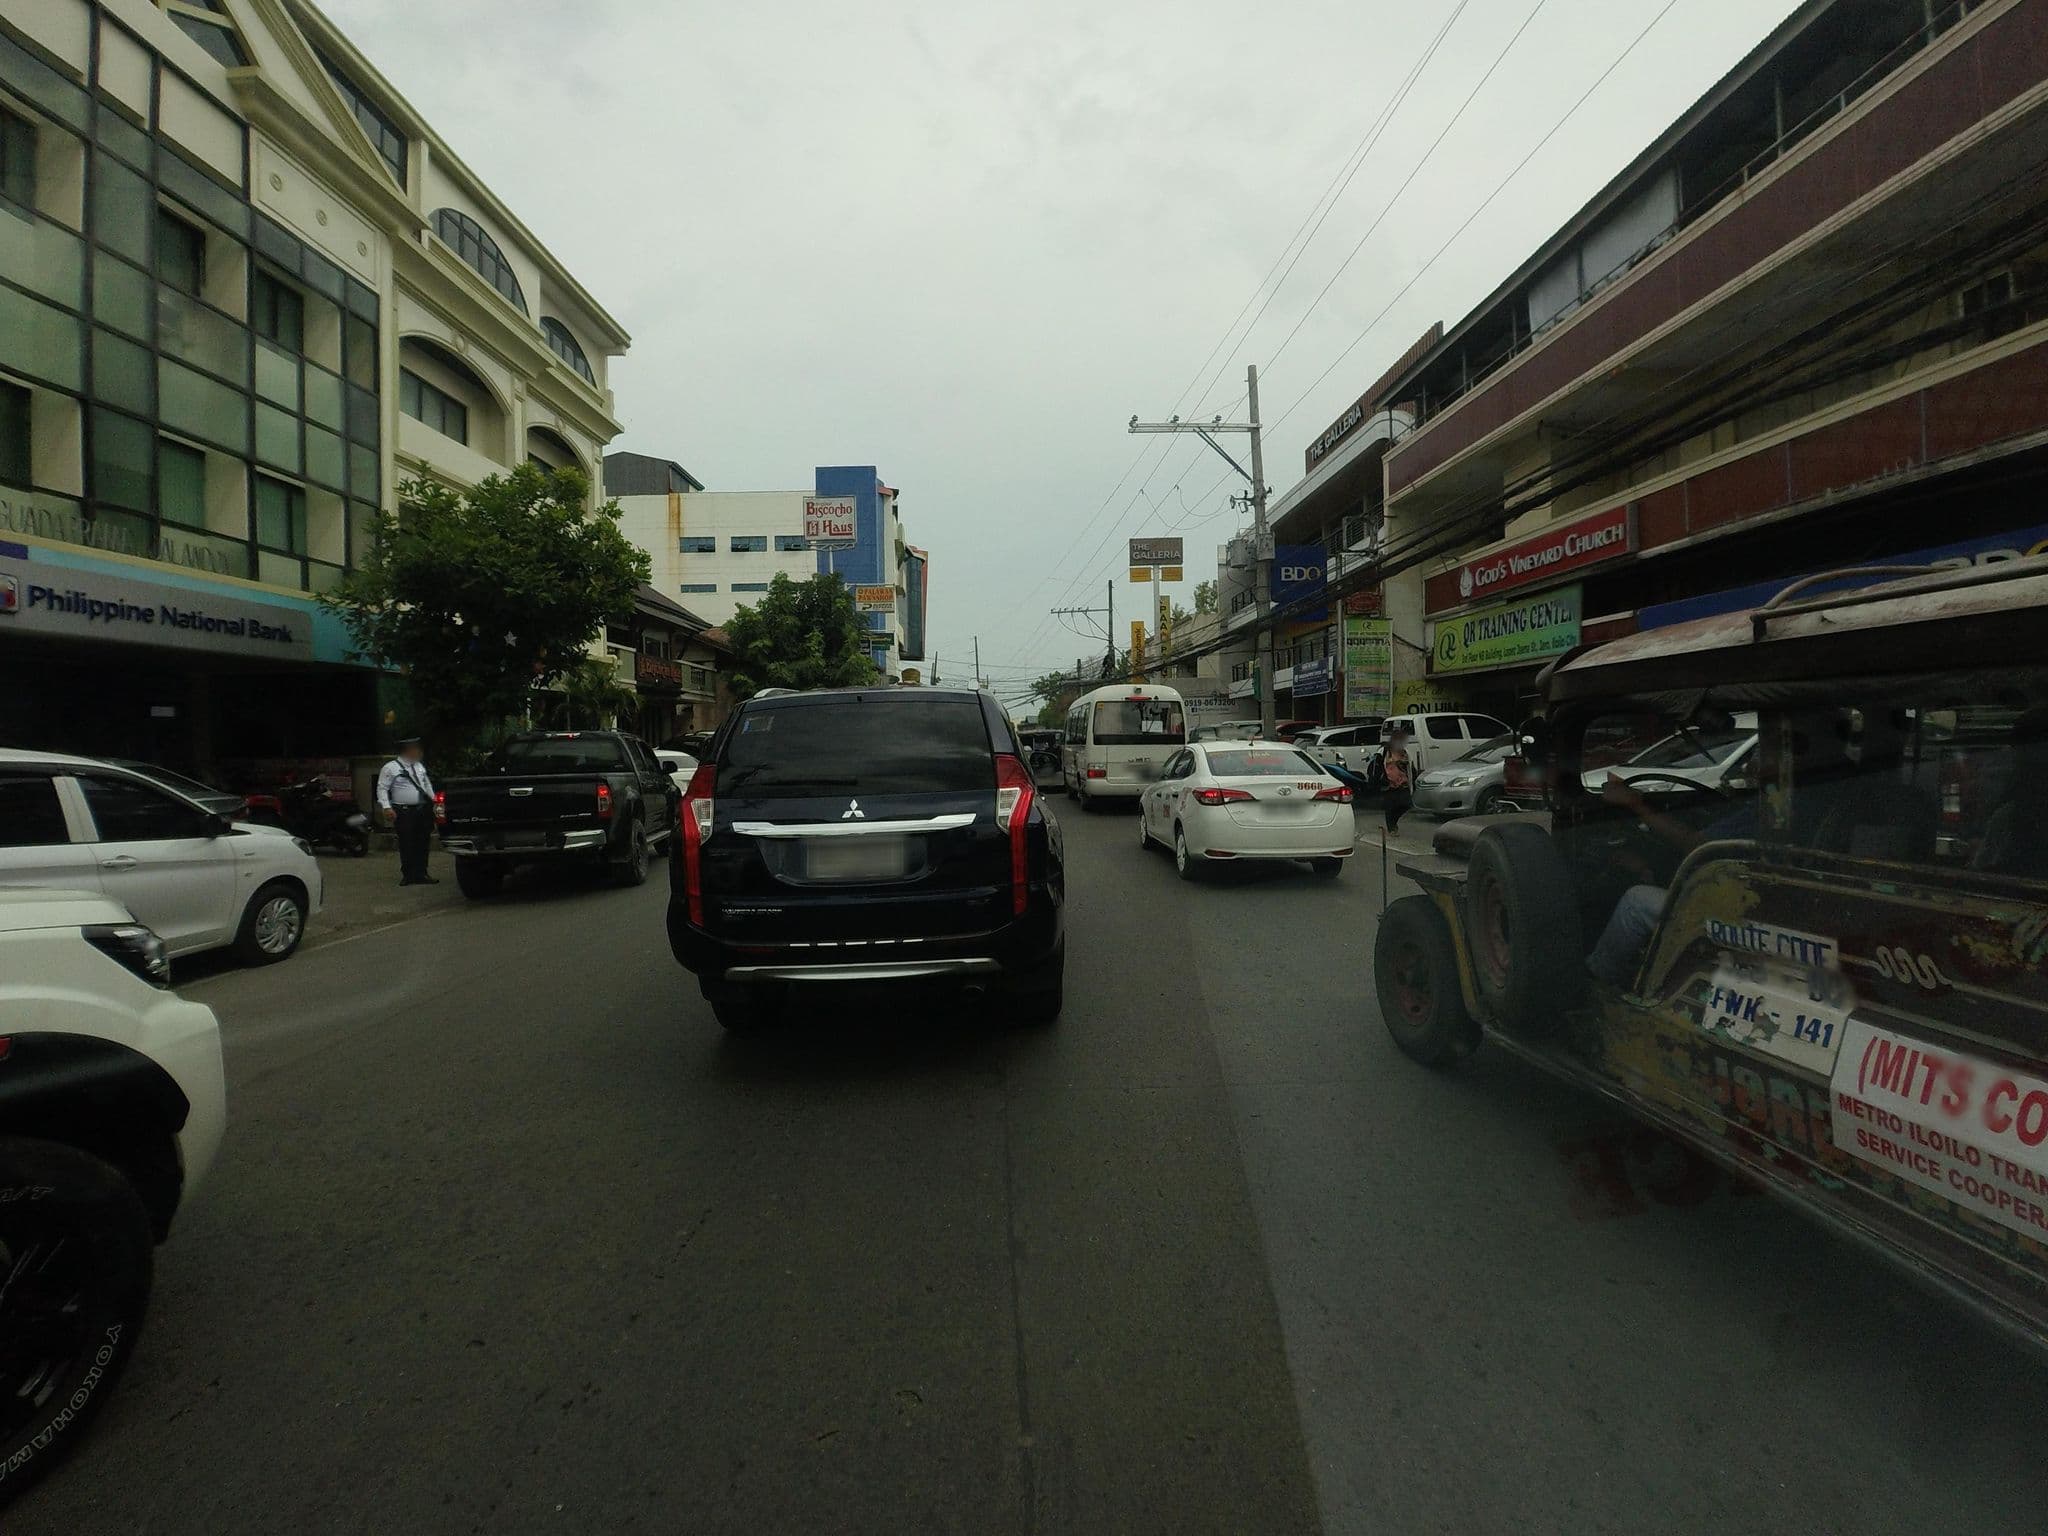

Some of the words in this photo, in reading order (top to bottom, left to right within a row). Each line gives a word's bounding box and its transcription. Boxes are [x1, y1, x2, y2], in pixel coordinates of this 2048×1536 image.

[1310, 442, 1325, 462] THE
[1324, 405, 1363, 449] GALLERIA
[806, 502, 853, 518] Biscocho
[823, 520, 853, 536] Haus
[1132, 551, 1180, 560] GALLERIA
[1133, 543, 1150, 551] THE
[1280, 566, 1321, 582] BDO
[27, 584, 155, 625] Philippine
[160, 605, 245, 638] National
[250, 619, 293, 643] Bank
[1478, 608, 1527, 641] TRAINING
[1794, 1014, 1834, 1048] 141
[1838, 1093, 1903, 1135] METRO
[1908, 1120, 1981, 1167] ILOILO
[1855, 1127, 1941, 1181] SERVICE
[1947, 1168, 2048, 1231] COOPER
